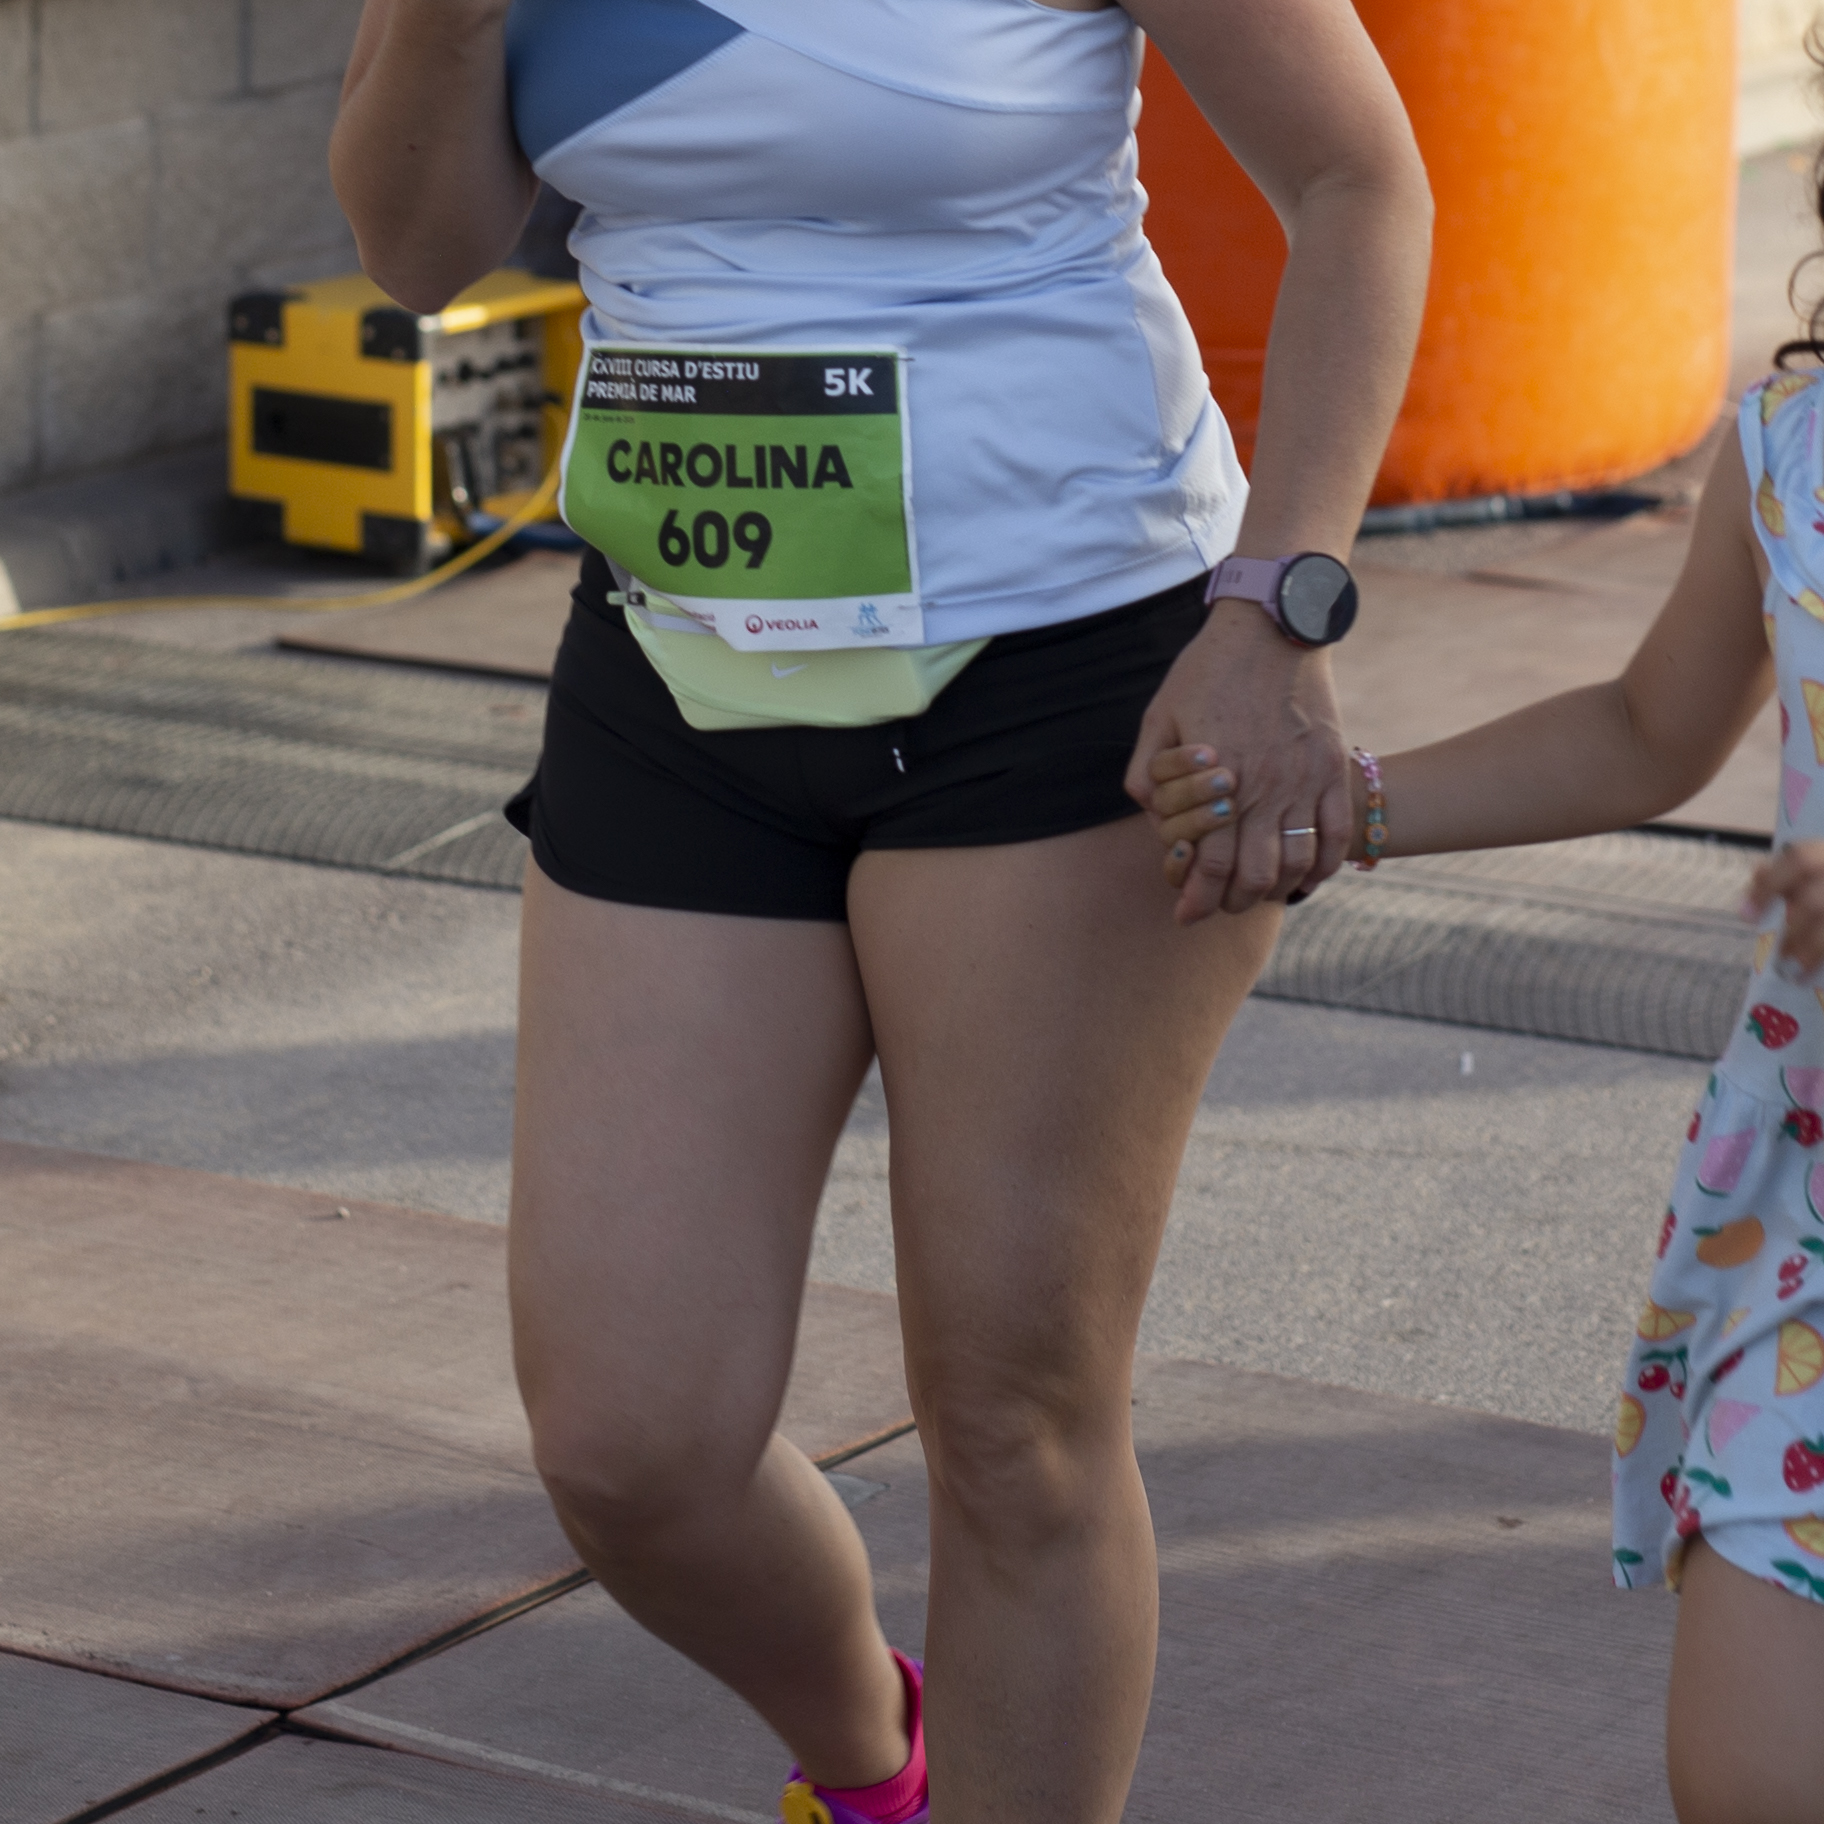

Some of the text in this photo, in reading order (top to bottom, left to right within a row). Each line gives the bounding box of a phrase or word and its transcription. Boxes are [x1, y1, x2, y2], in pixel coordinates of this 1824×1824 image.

[635, 358, 681, 379] CURSA
[684, 360, 760, 381] D'ESTIU
[824, 367, 874, 397] 5K
[639, 382, 659, 402] DE
[661, 383, 698, 404] MAR
[606, 438, 854, 489] CAROLINA
[658, 509, 773, 570] 609
[766, 618, 820, 632] VEOLIA
